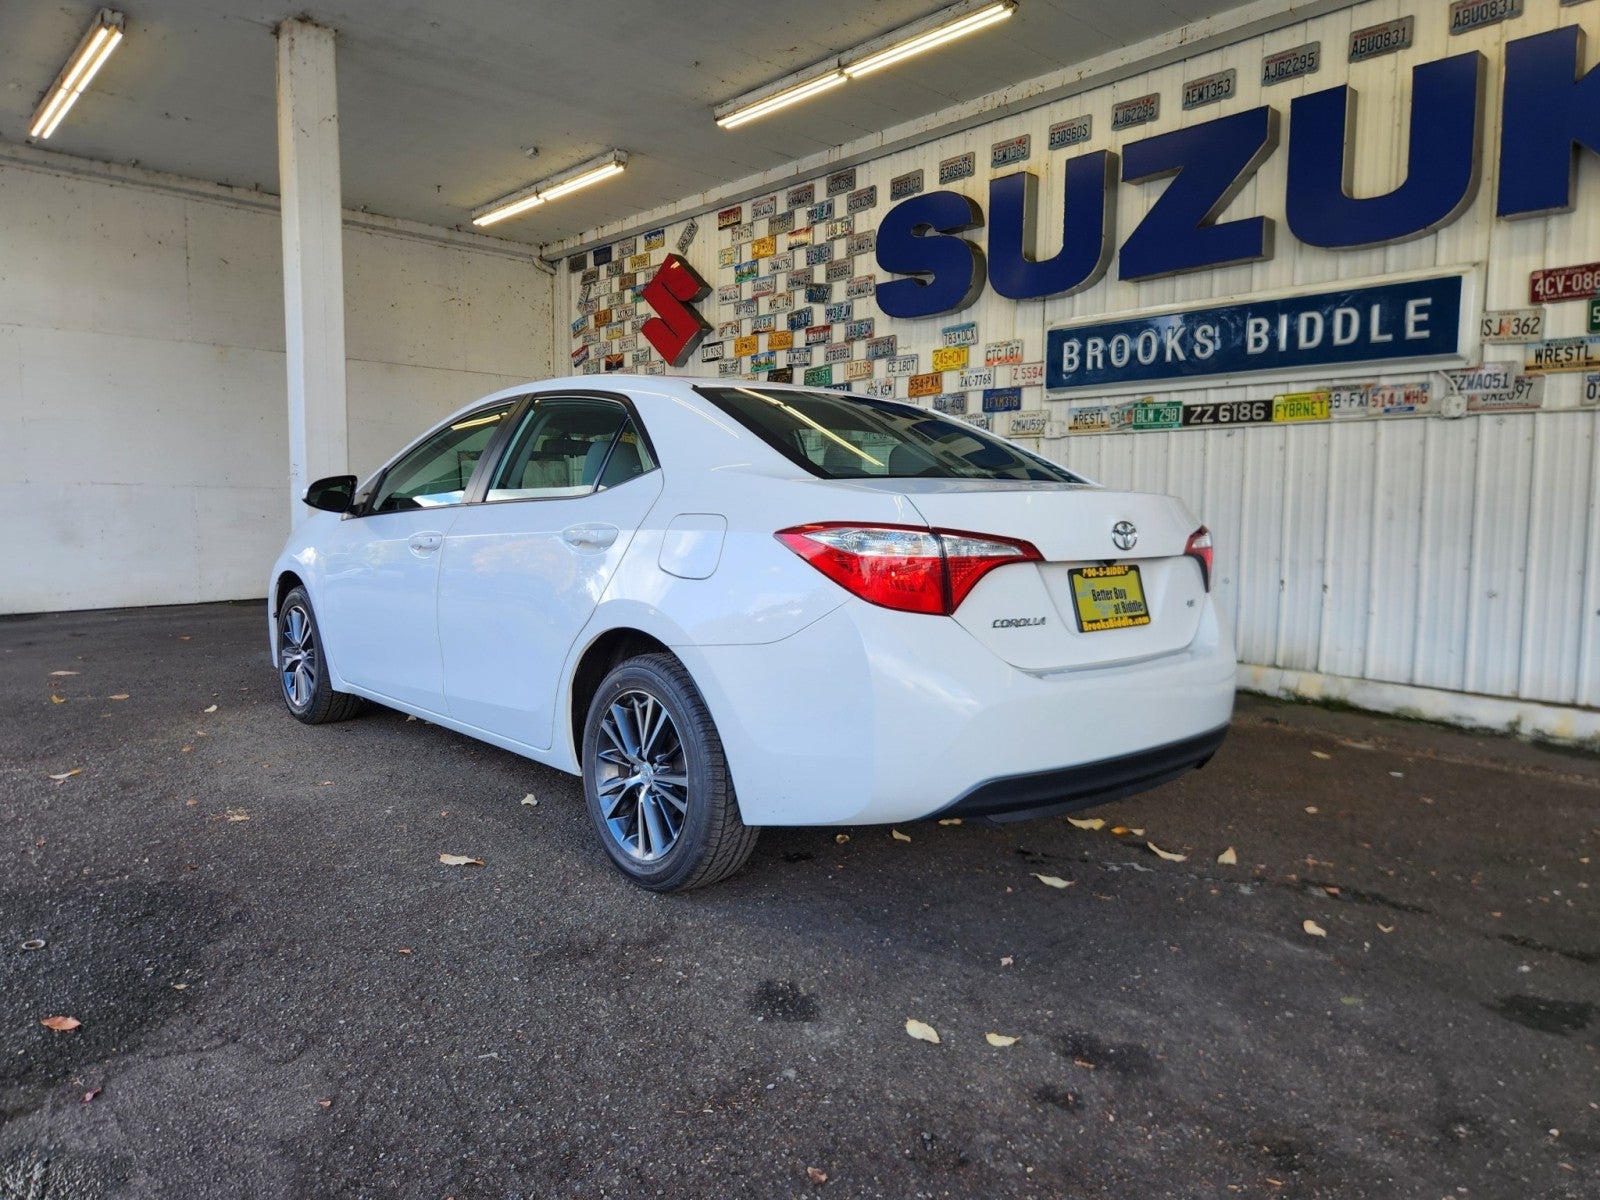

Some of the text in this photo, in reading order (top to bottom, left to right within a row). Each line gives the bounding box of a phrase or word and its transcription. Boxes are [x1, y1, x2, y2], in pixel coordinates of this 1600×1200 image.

[1351, 27, 1406, 57] ABU0831
[1263, 51, 1315, 81] AJG2295
[1062, 297, 1432, 373] BROOKS BIDDLE
[1511, 317, 1541, 335] 362
[1535, 344, 1594, 364] WRESTL
[1189, 402, 1265, 424] ZZ 6186
[1091, 587, 1127, 602] Better Buy
[1113, 600, 1144, 614] at Biddle
[992, 616, 1046, 628] COROLLA
[1082, 615, 1150, 632] BrooksBiddle.com
